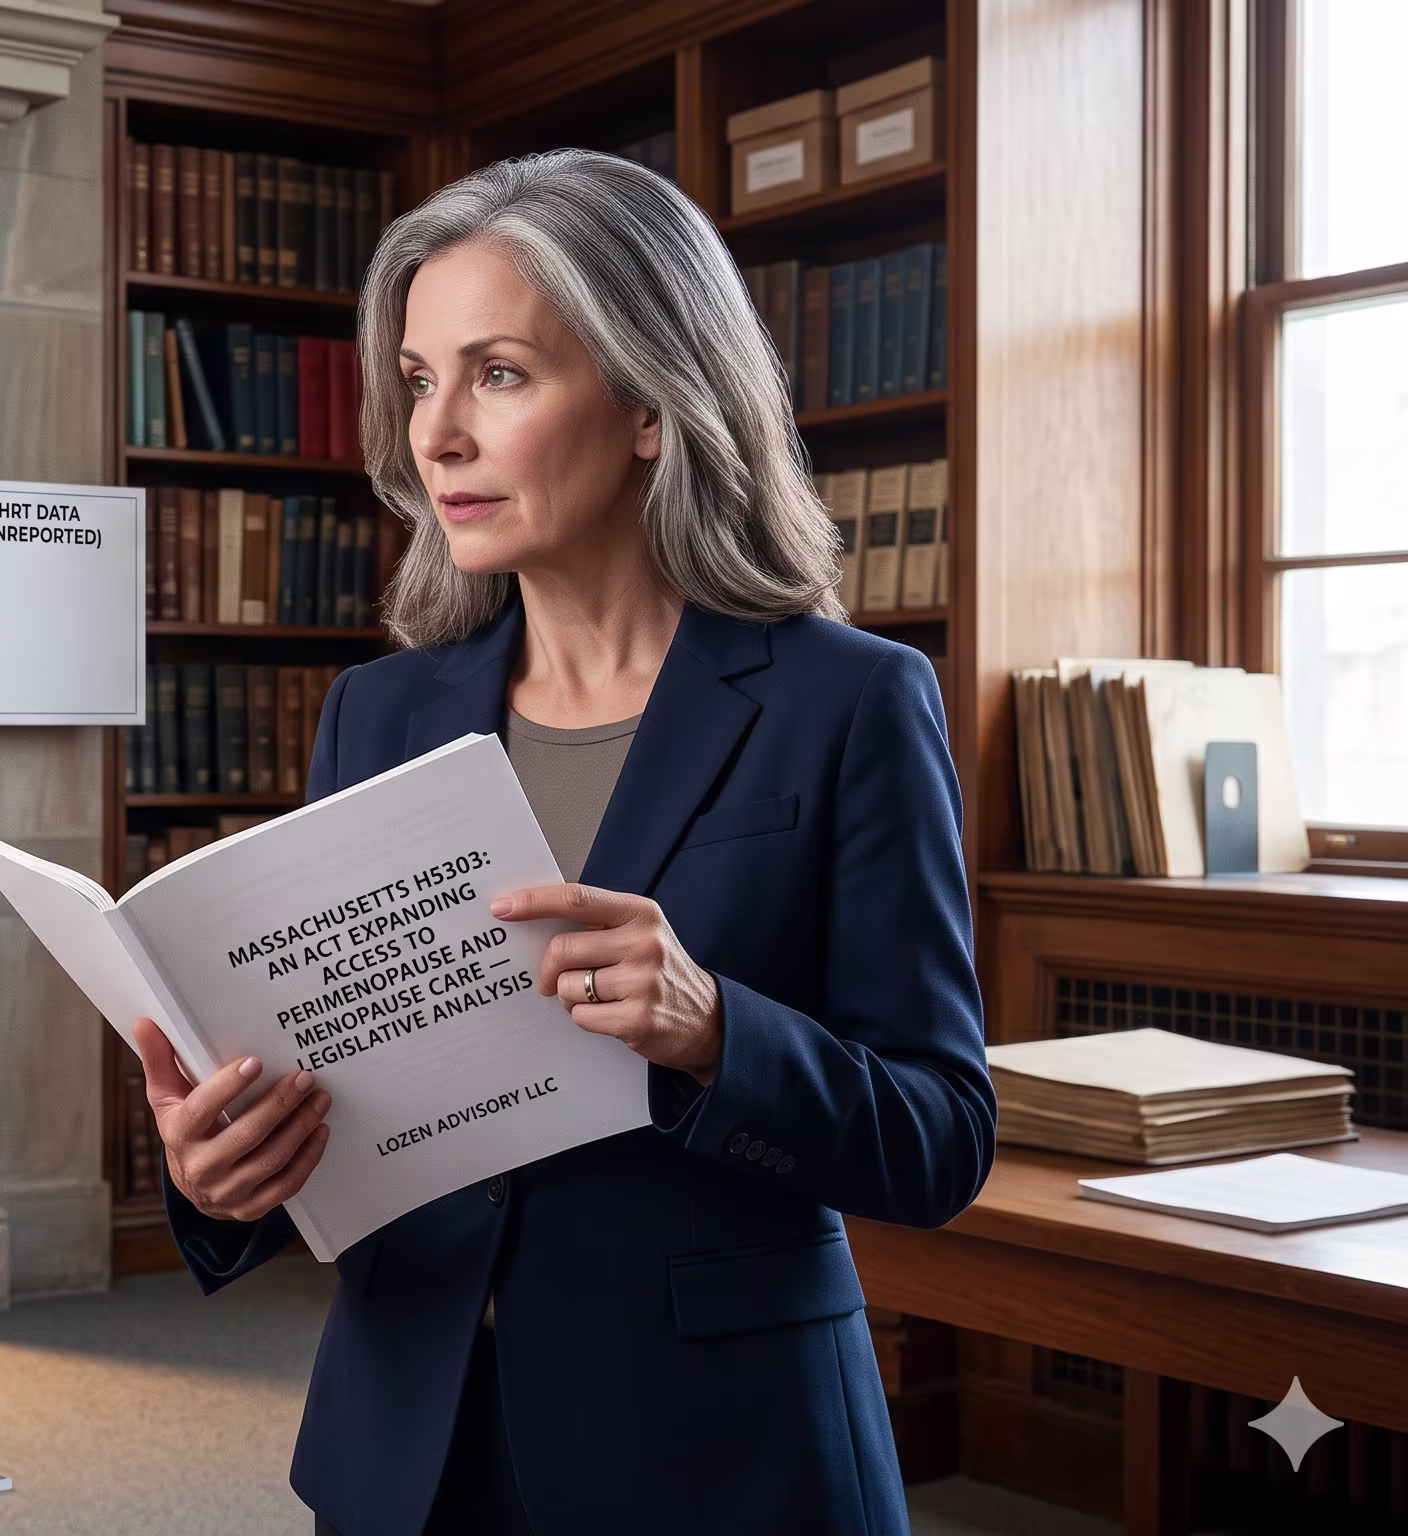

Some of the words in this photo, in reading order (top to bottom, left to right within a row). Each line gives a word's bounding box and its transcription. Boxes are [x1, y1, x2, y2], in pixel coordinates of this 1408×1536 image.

[37, 504, 81, 522] DATA
[227, 879, 410, 969] MASSACHUSETTS
[413, 850, 491, 893] H5303:
[267, 957, 299, 981] AN
[303, 934, 344, 967] ACT
[347, 882, 477, 947] EXPANDING
[322, 939, 402, 986] ACCESS
[403, 926, 436, 954] TO
[276, 945, 456, 1030] PERIMENOPAUSE
[461, 926, 508, 959] AND
[294, 984, 426, 1050] MENOPAUSE
[428, 961, 485, 997] CARE
[296, 1011, 429, 1073] LEGISLATIVE
[432, 970, 533, 1025] ANALYSIS
[376, 1124, 433, 1157] LOZEN
[437, 1090, 522, 1134] ADVISORY
[524, 1077, 559, 1101] LLC
